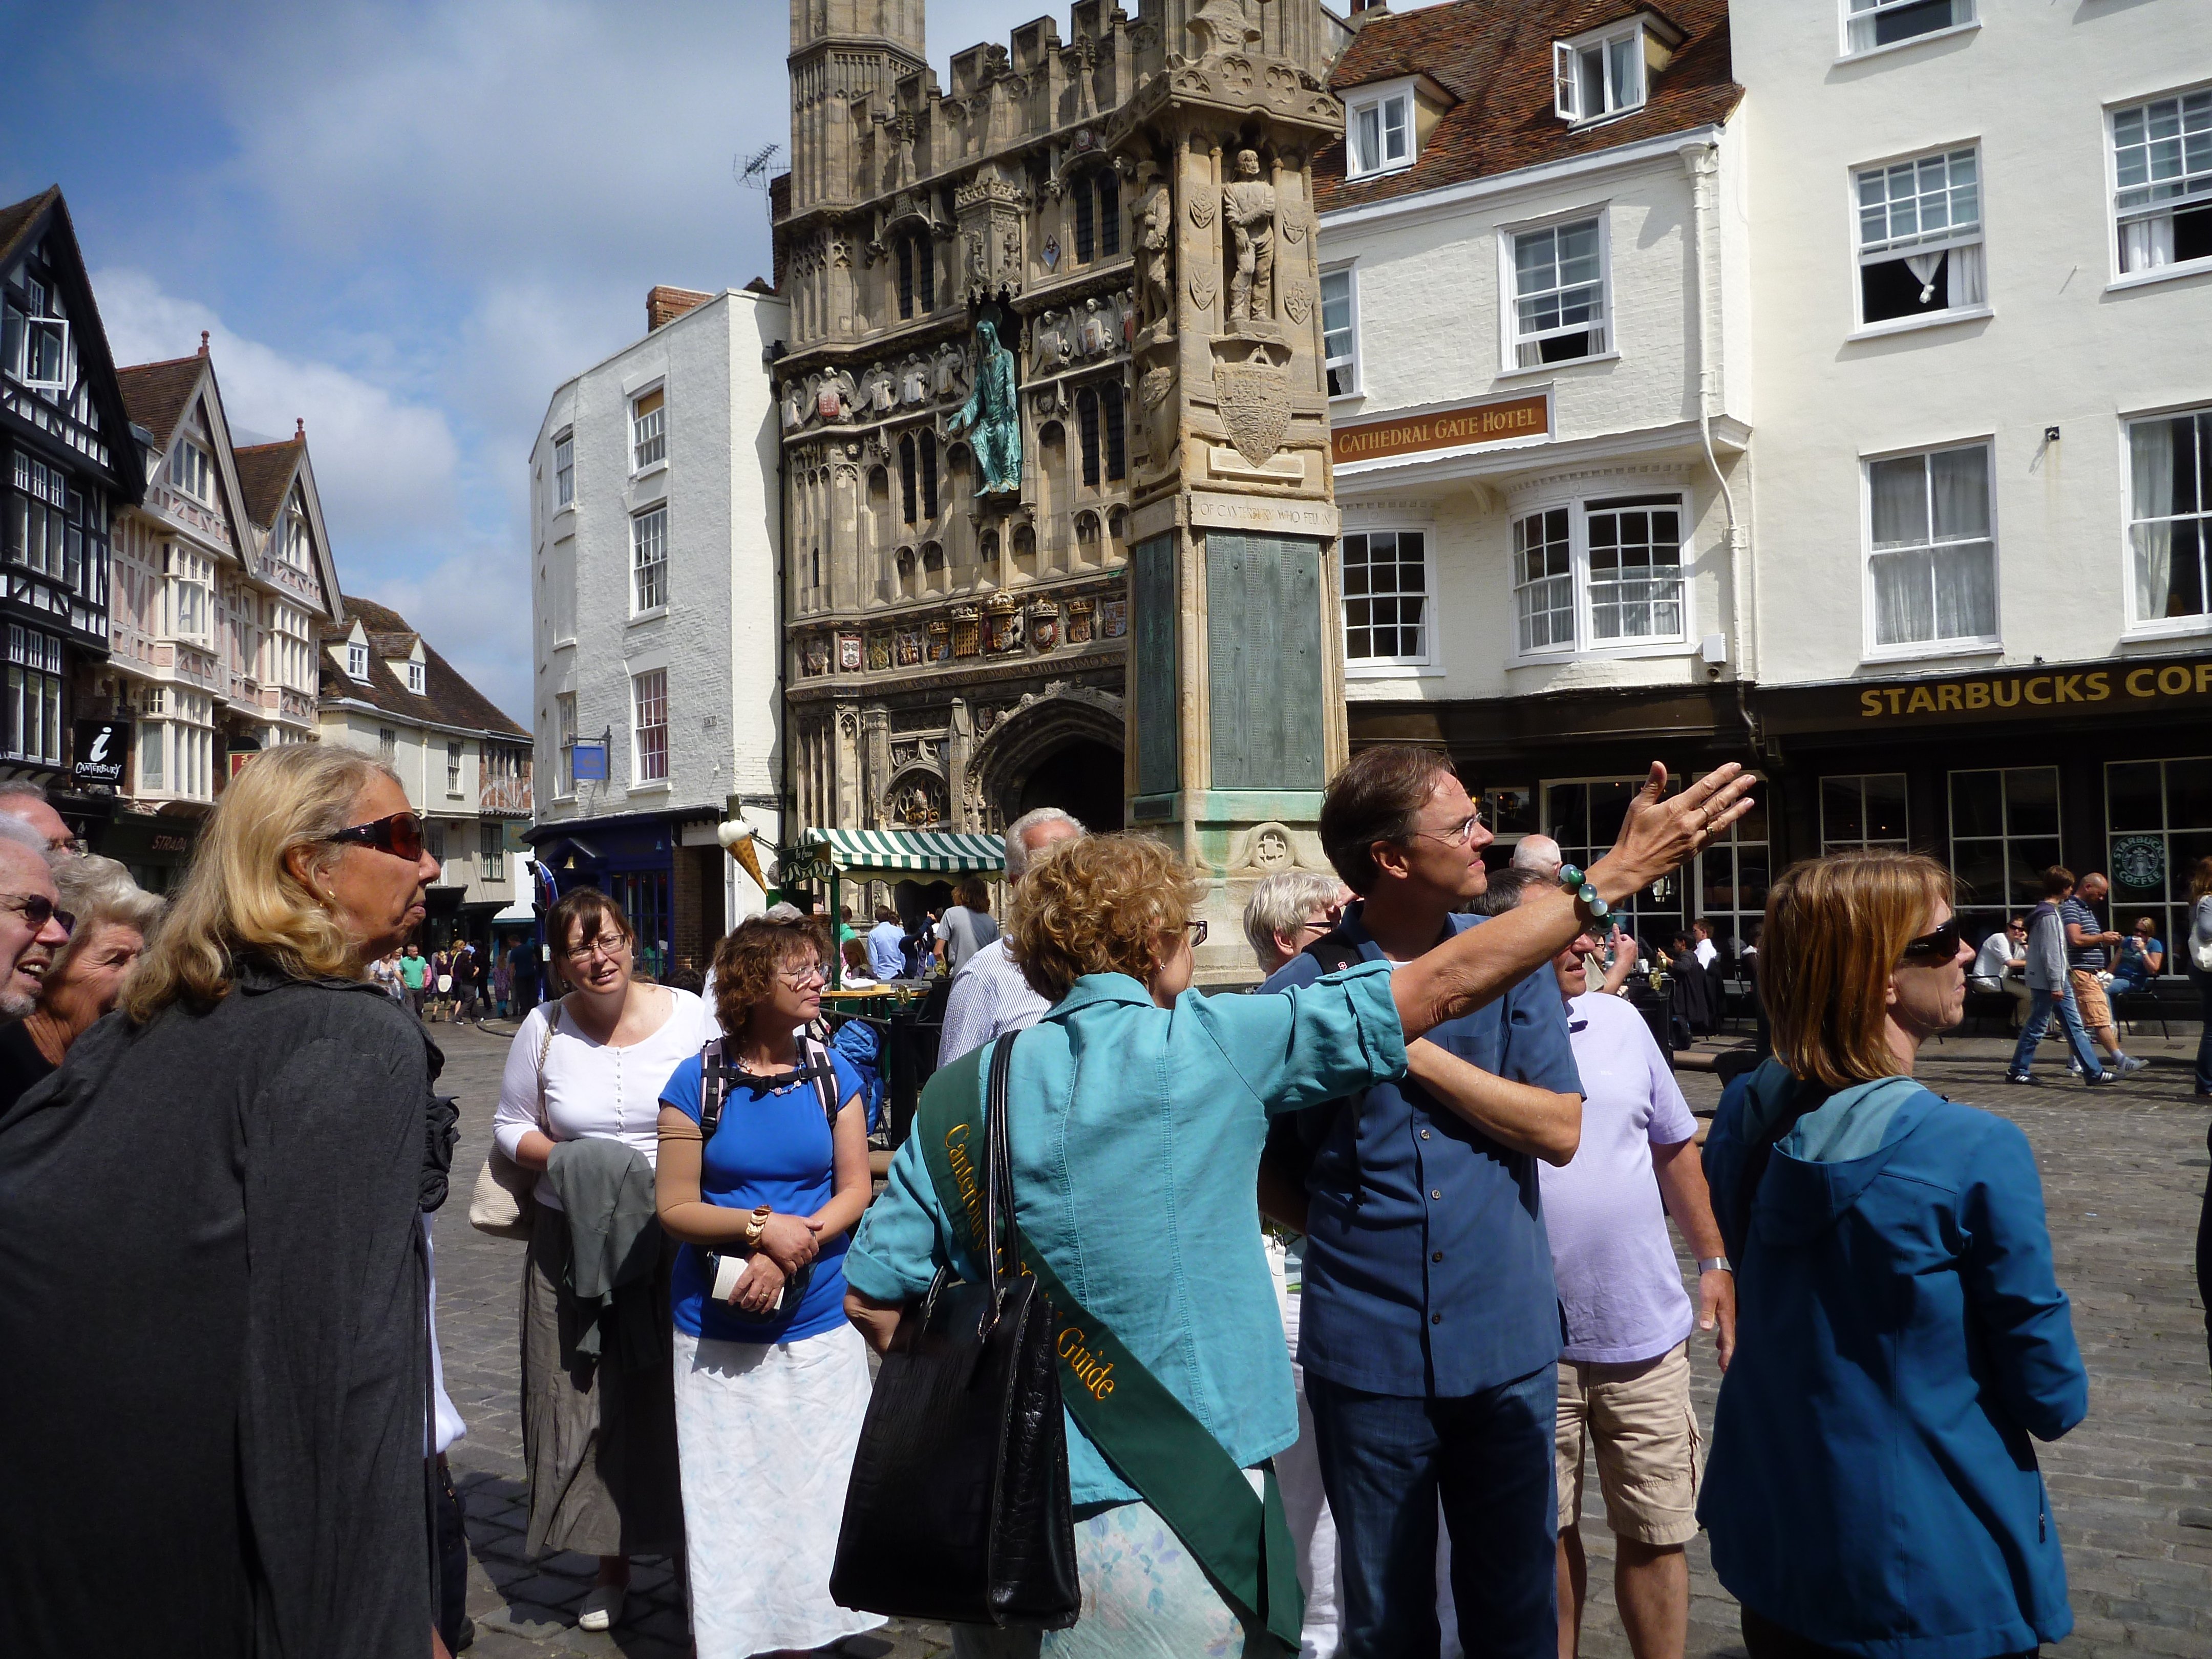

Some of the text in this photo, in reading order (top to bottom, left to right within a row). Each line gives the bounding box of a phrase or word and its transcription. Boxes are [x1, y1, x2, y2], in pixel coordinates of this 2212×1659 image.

[1338, 409, 1537, 454] CATHEDRAL GATE HOTEL
[1200, 503, 1331, 525] OF CANTERBURY WHO FELL IN
[943, 673, 972, 685] ANNO
[1861, 672, 2110, 717] STARBUCKS
[75, 762, 122, 779] CANTERBURY
[2113, 836, 2164, 859] STARBUCKS
[2119, 870, 2161, 885] COFFEE
[945, 1123, 987, 1252] Canterbury
[1057, 1327, 1114, 1401] Guide
